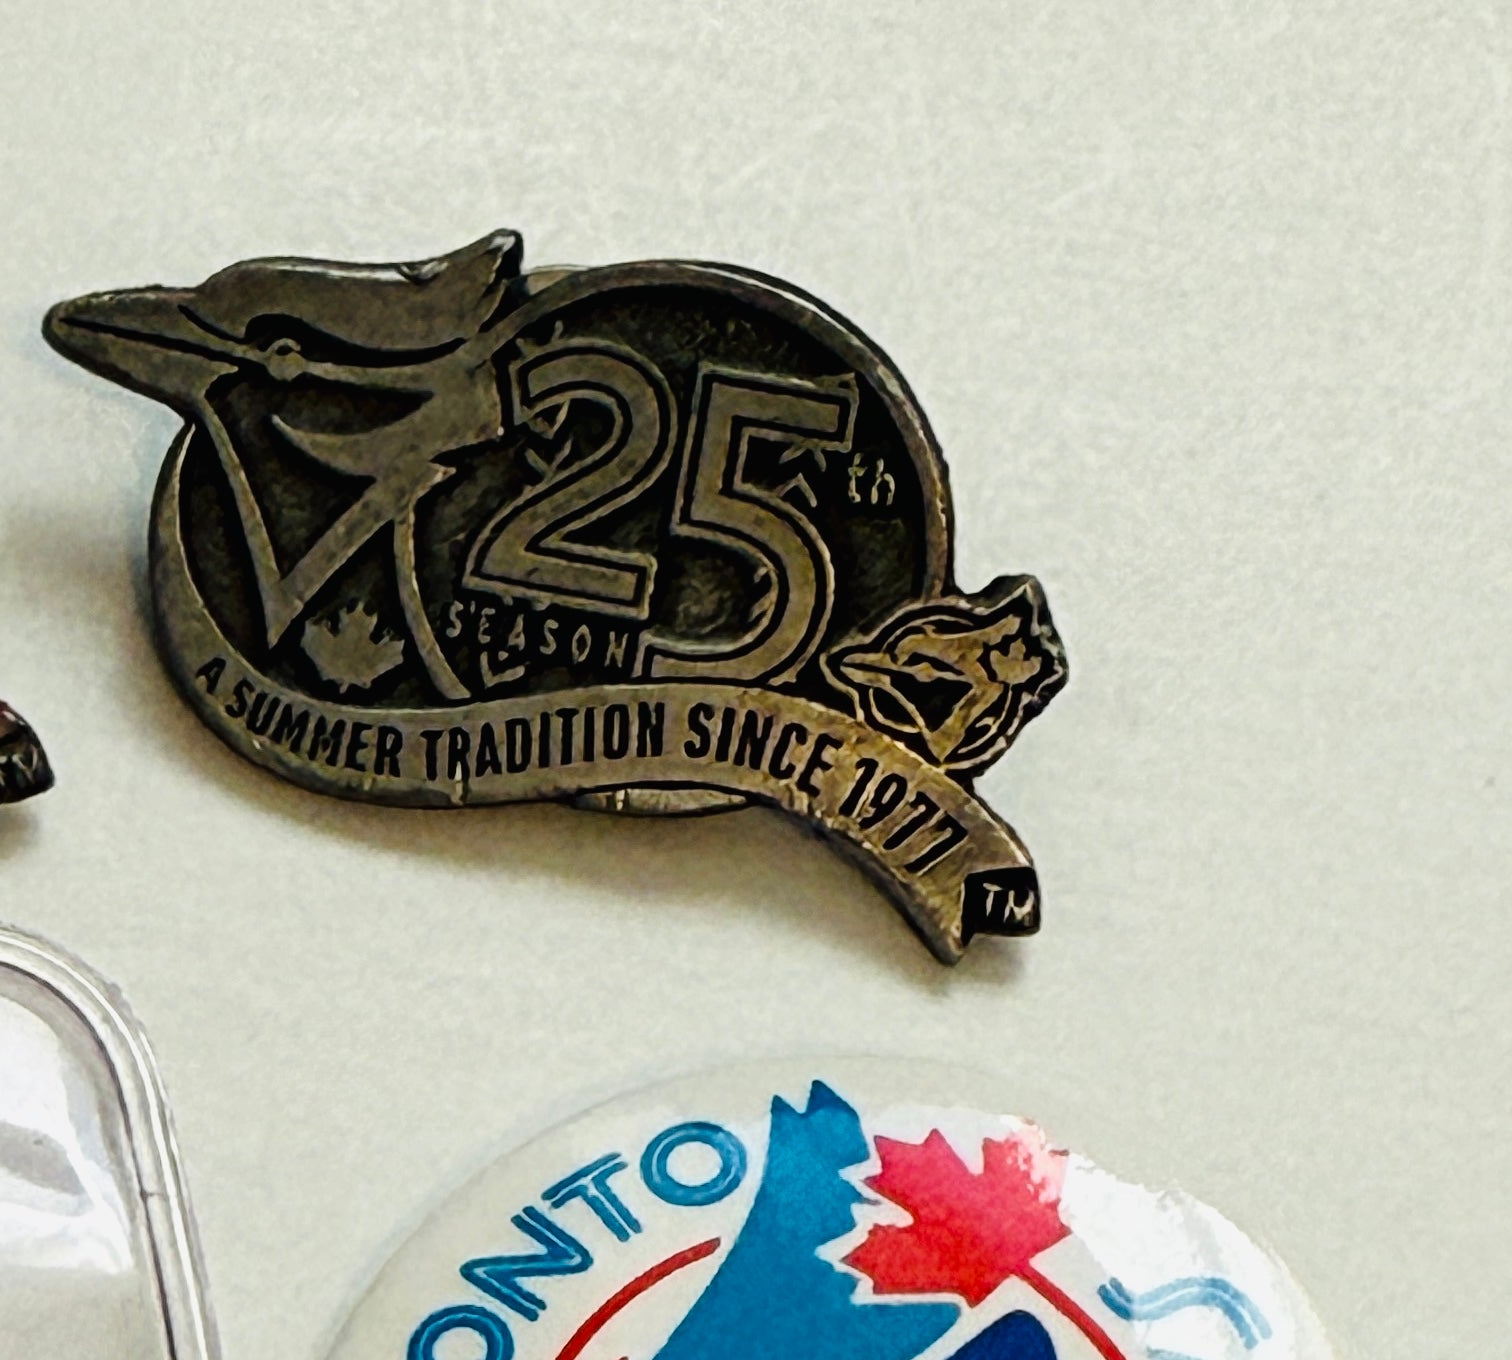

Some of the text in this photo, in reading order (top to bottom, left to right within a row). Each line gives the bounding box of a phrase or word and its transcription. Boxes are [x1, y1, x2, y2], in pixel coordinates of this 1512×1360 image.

[445, 600, 630, 669] SEASON
[194, 656, 970, 875] A SUMMER TRADITION SINCE 1977
[980, 883, 1037, 924] TM
